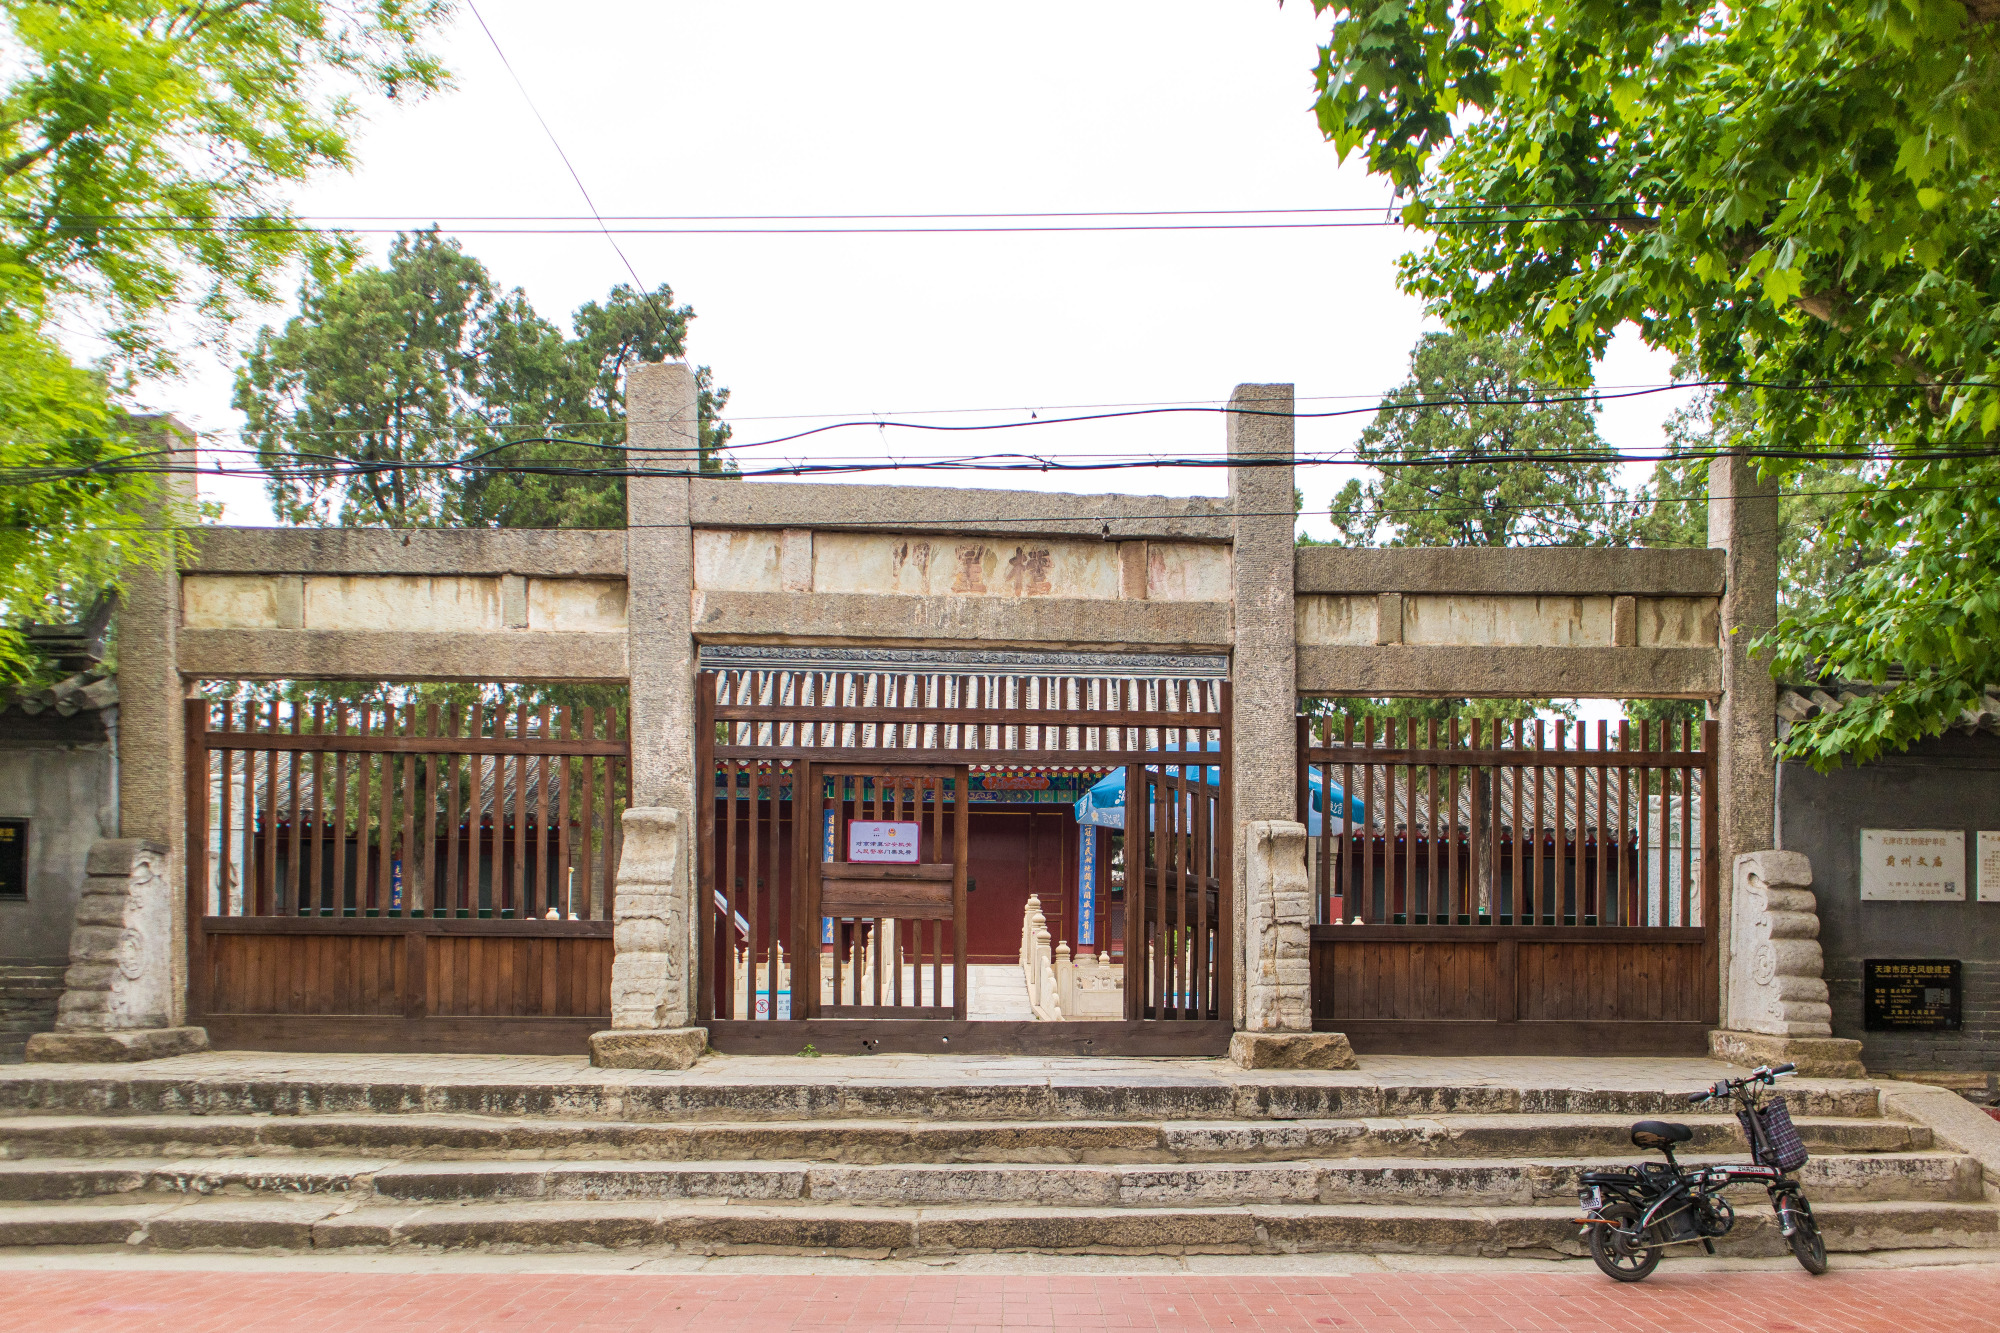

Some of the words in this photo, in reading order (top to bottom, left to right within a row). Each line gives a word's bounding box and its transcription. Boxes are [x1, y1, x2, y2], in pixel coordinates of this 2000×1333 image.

[1882, 837, 1947, 846] 天津市文物保护单位
[1874, 965, 1951, 974] 天津市历史风貌建筑
